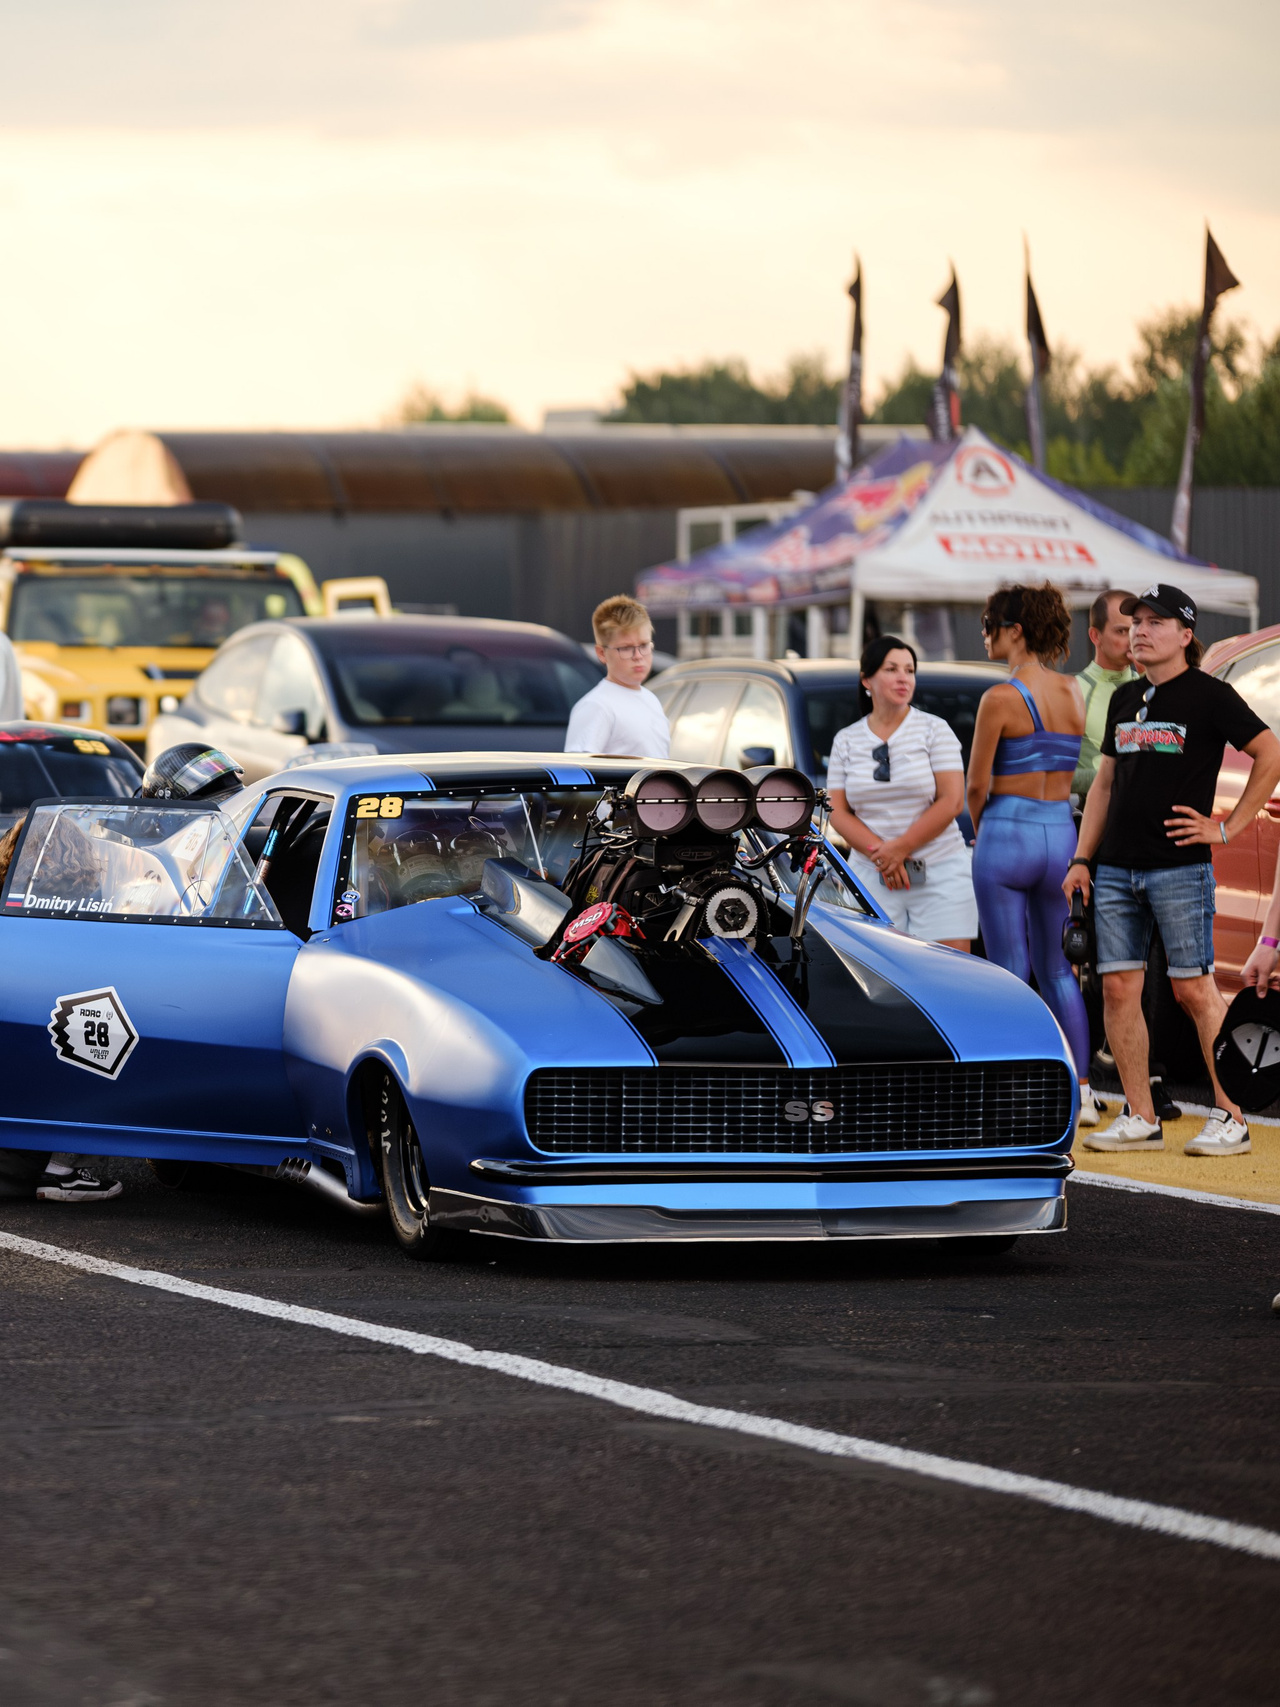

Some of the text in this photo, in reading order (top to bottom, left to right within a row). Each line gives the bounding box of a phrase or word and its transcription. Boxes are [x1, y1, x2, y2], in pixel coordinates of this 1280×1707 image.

[355, 796, 404, 818] 28
[24, 894, 113, 914] Dmitry Lisin
[570, 911, 603, 932] MSD
[80, 1008, 101, 1018] RDRC
[83, 1020, 110, 1048] 28
[784, 1100, 835, 1122] SS
